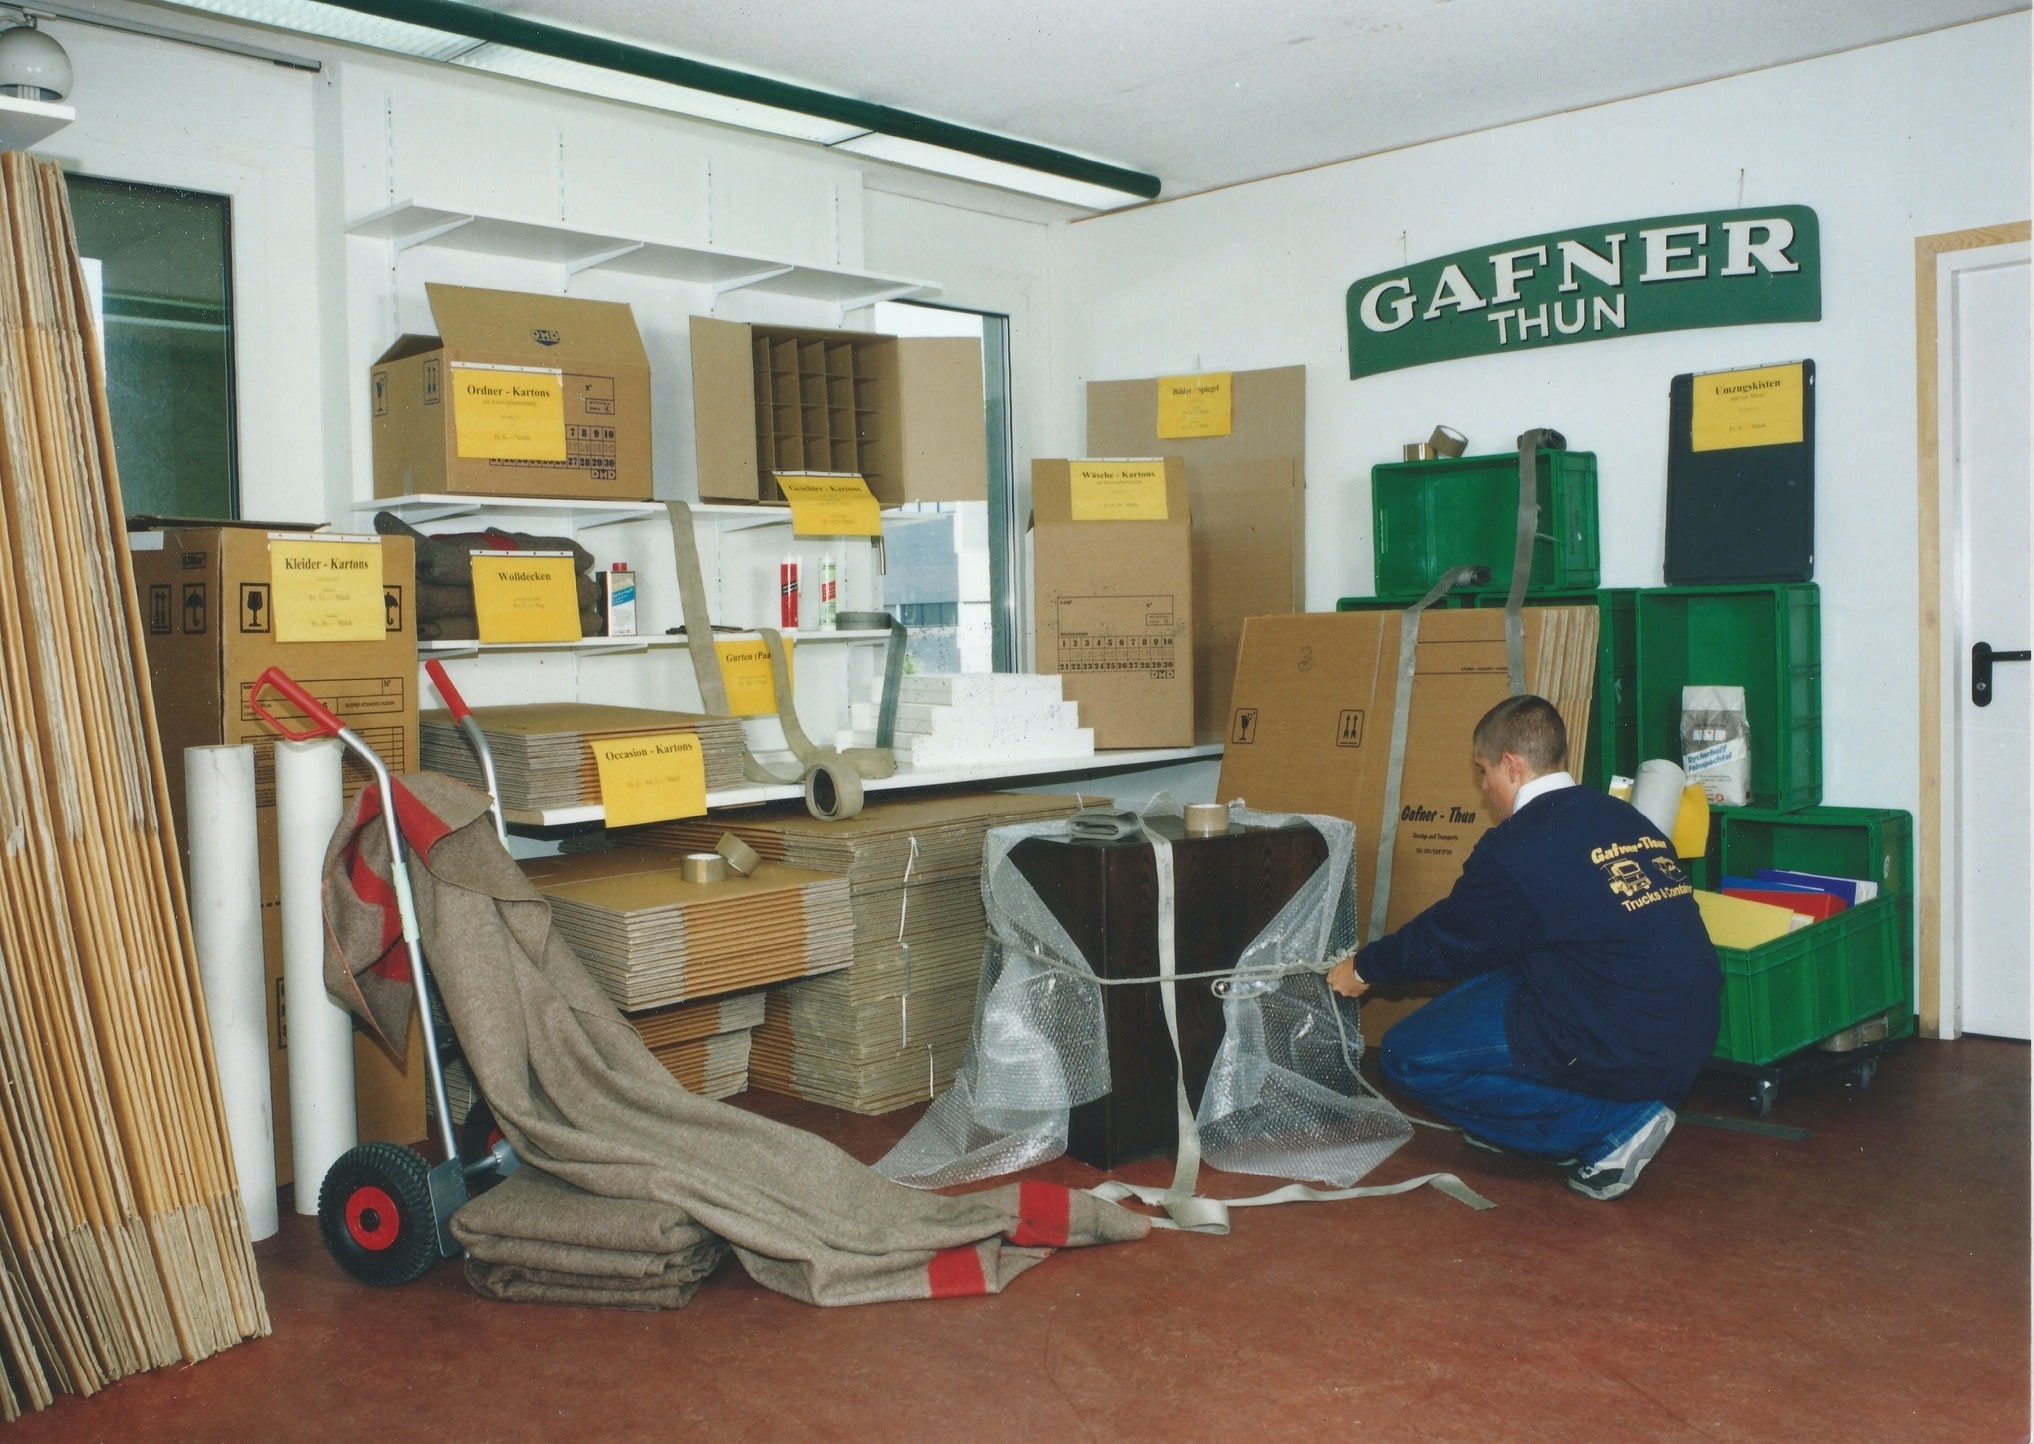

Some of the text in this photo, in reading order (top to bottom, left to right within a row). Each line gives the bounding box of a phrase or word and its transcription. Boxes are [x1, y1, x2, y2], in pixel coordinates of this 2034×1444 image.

[1360, 217, 1799, 333] GAFNER
[1487, 293, 1626, 345] THUN
[467, 385, 502, 396] Ordner
[513, 386, 550, 397] Kartons
[1173, 387, 1191, 395] Bilder
[1198, 384, 1219, 395] Spiegel
[1716, 380, 1780, 395] Umzugskisten
[570, 428, 614, 439] 7 8 9 10
[567, 457, 577, 466] 27
[580, 458, 590, 467] 28
[592, 458, 602, 467] 29
[604, 459, 614, 467] 30
[591, 469, 616, 479] DMD
[1082, 471, 1113, 479] Wäsche
[285, 558, 321, 570] Kleider
[331, 558, 369, 570] Kartons
[499, 571, 552, 581] Wolldecken
[726, 651, 771, 662] Gurten (Paa
[1083, 662, 1093, 670] 23
[1094, 662, 1104, 670] 24
[1118, 661, 1128, 669] 26
[1129, 661, 1139, 669] 27
[1141, 661, 1150, 669] 28
[605, 748, 648, 761] Occasion
[656, 742, 693, 755] Kartons
[1401, 805, 1438, 822] Gafner
[1449, 806, 1476, 824] Thun
[1621, 892, 1662, 912] Trucks
